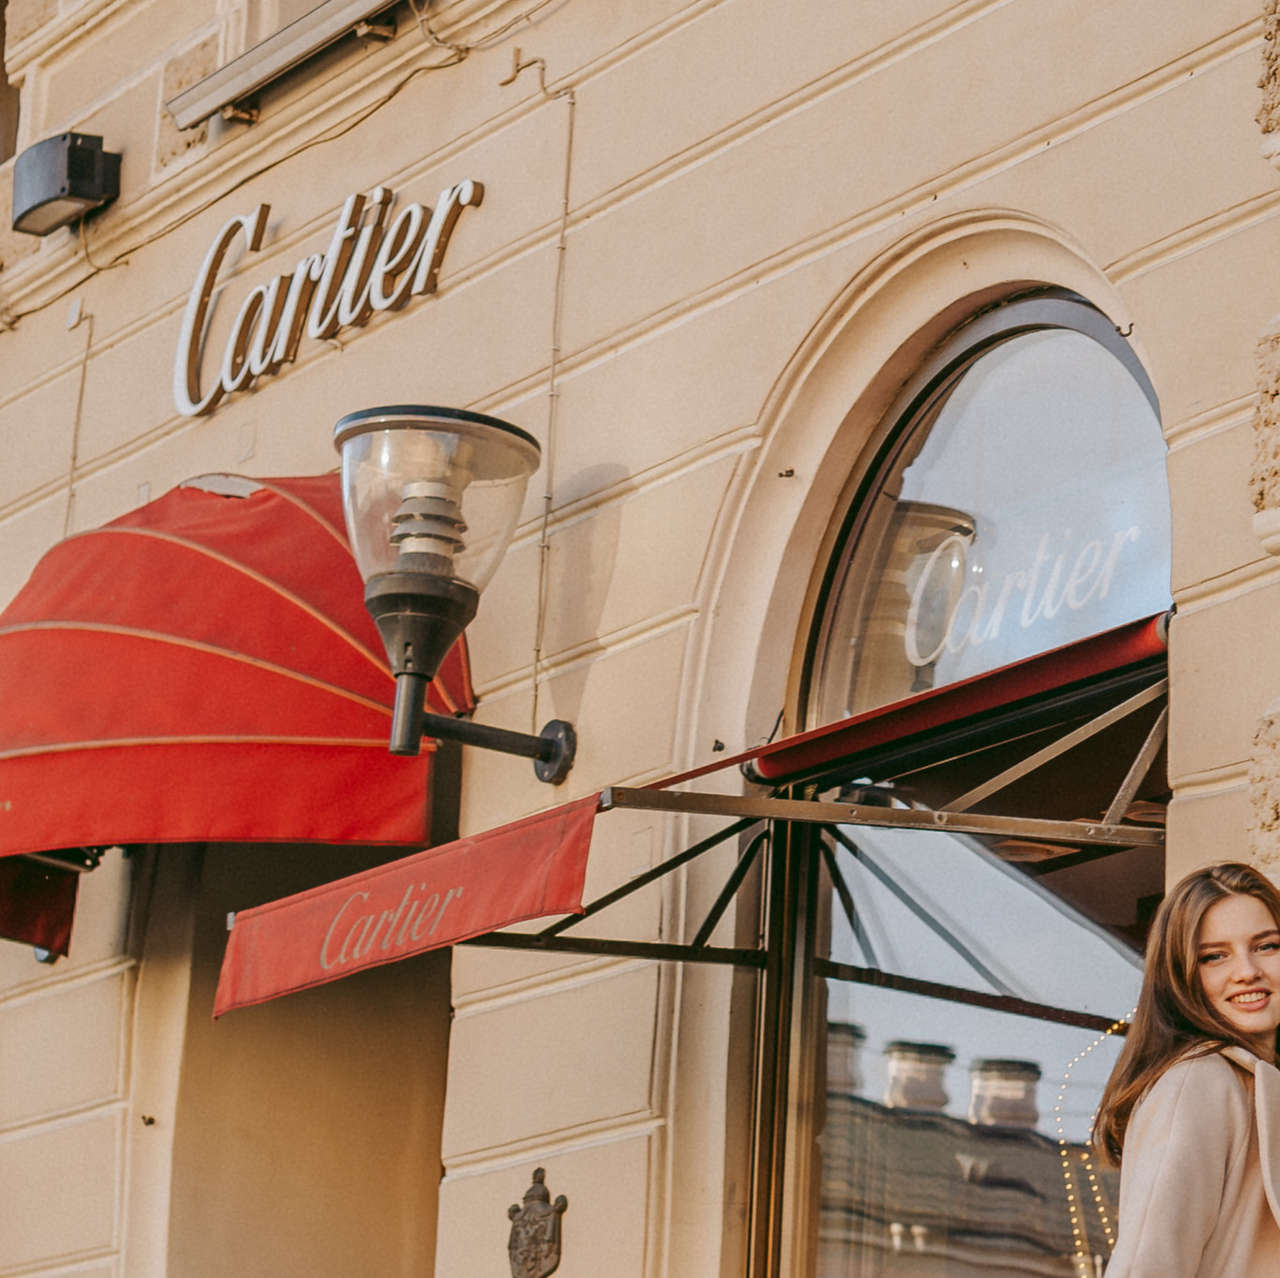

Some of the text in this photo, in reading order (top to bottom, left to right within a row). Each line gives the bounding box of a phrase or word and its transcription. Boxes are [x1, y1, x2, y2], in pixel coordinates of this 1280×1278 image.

[173, 179, 485, 417] Cartier
[904, 523, 1141, 667] Cartier
[320, 883, 464, 970] Cartier
